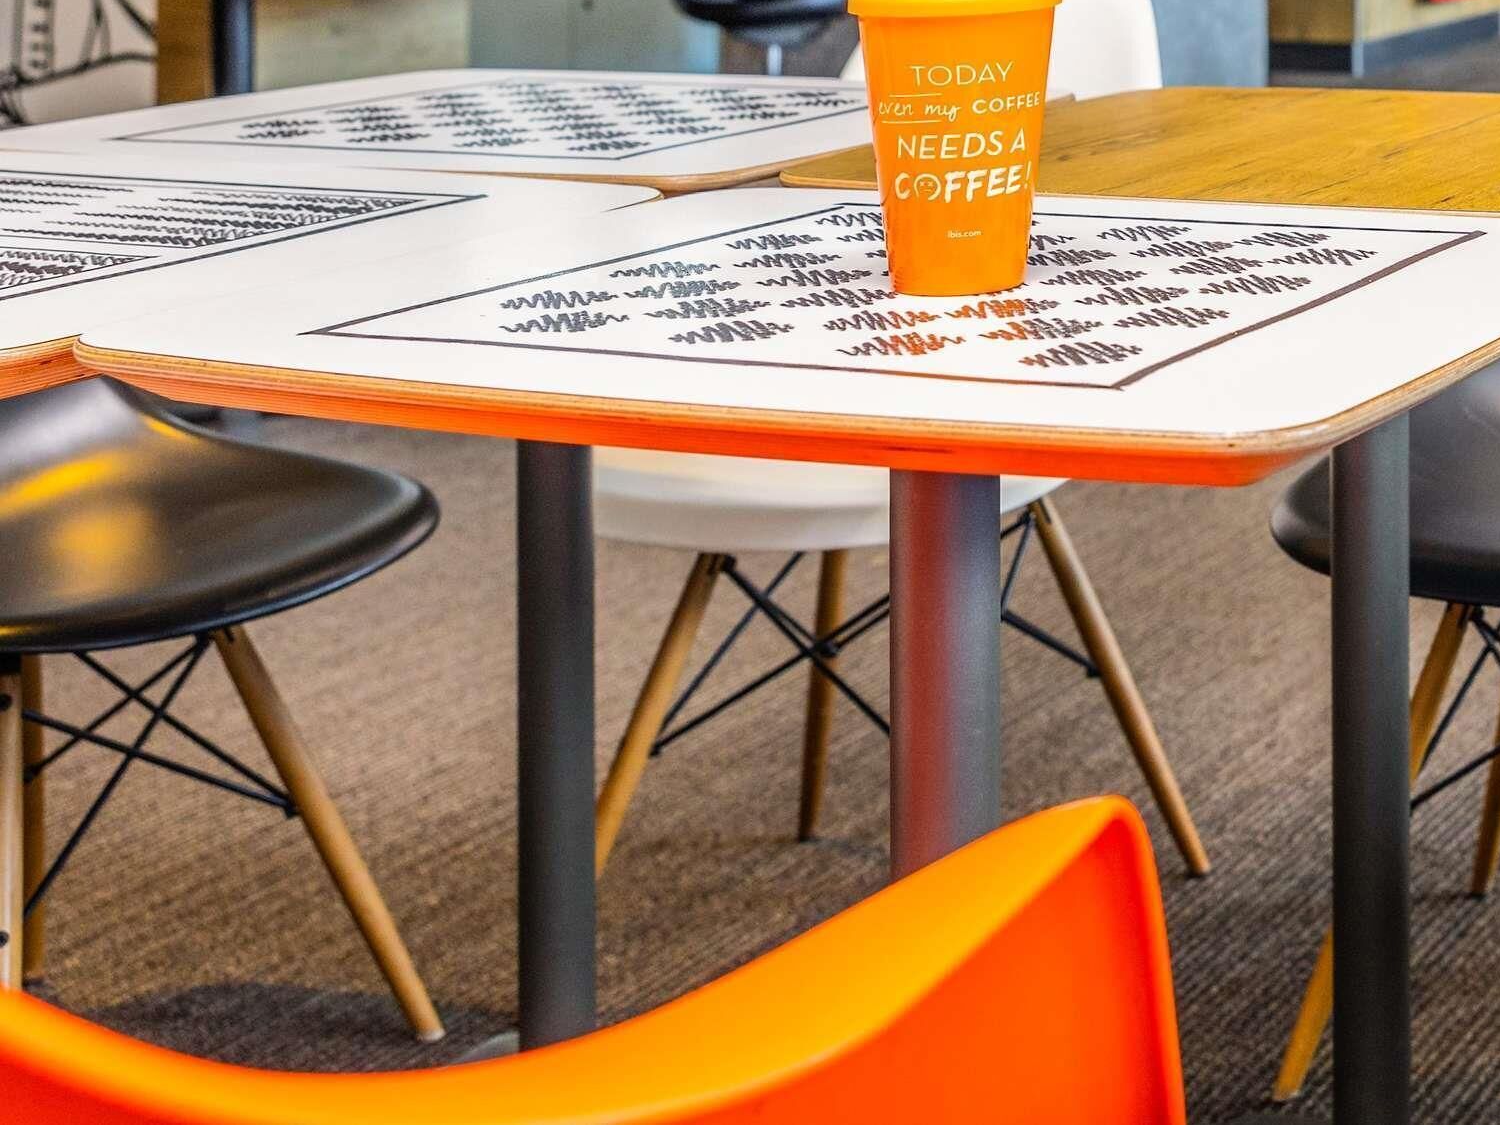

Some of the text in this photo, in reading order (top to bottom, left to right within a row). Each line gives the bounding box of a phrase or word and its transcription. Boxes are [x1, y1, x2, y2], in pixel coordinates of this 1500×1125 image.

[909, 61, 1013, 86] TODAY
[879, 91, 1041, 122] even my COFFEE
[897, 127, 1026, 160] NEEDS A
[894, 160, 1032, 204] COFFEE!
[947, 230, 982, 239] ibis.com
